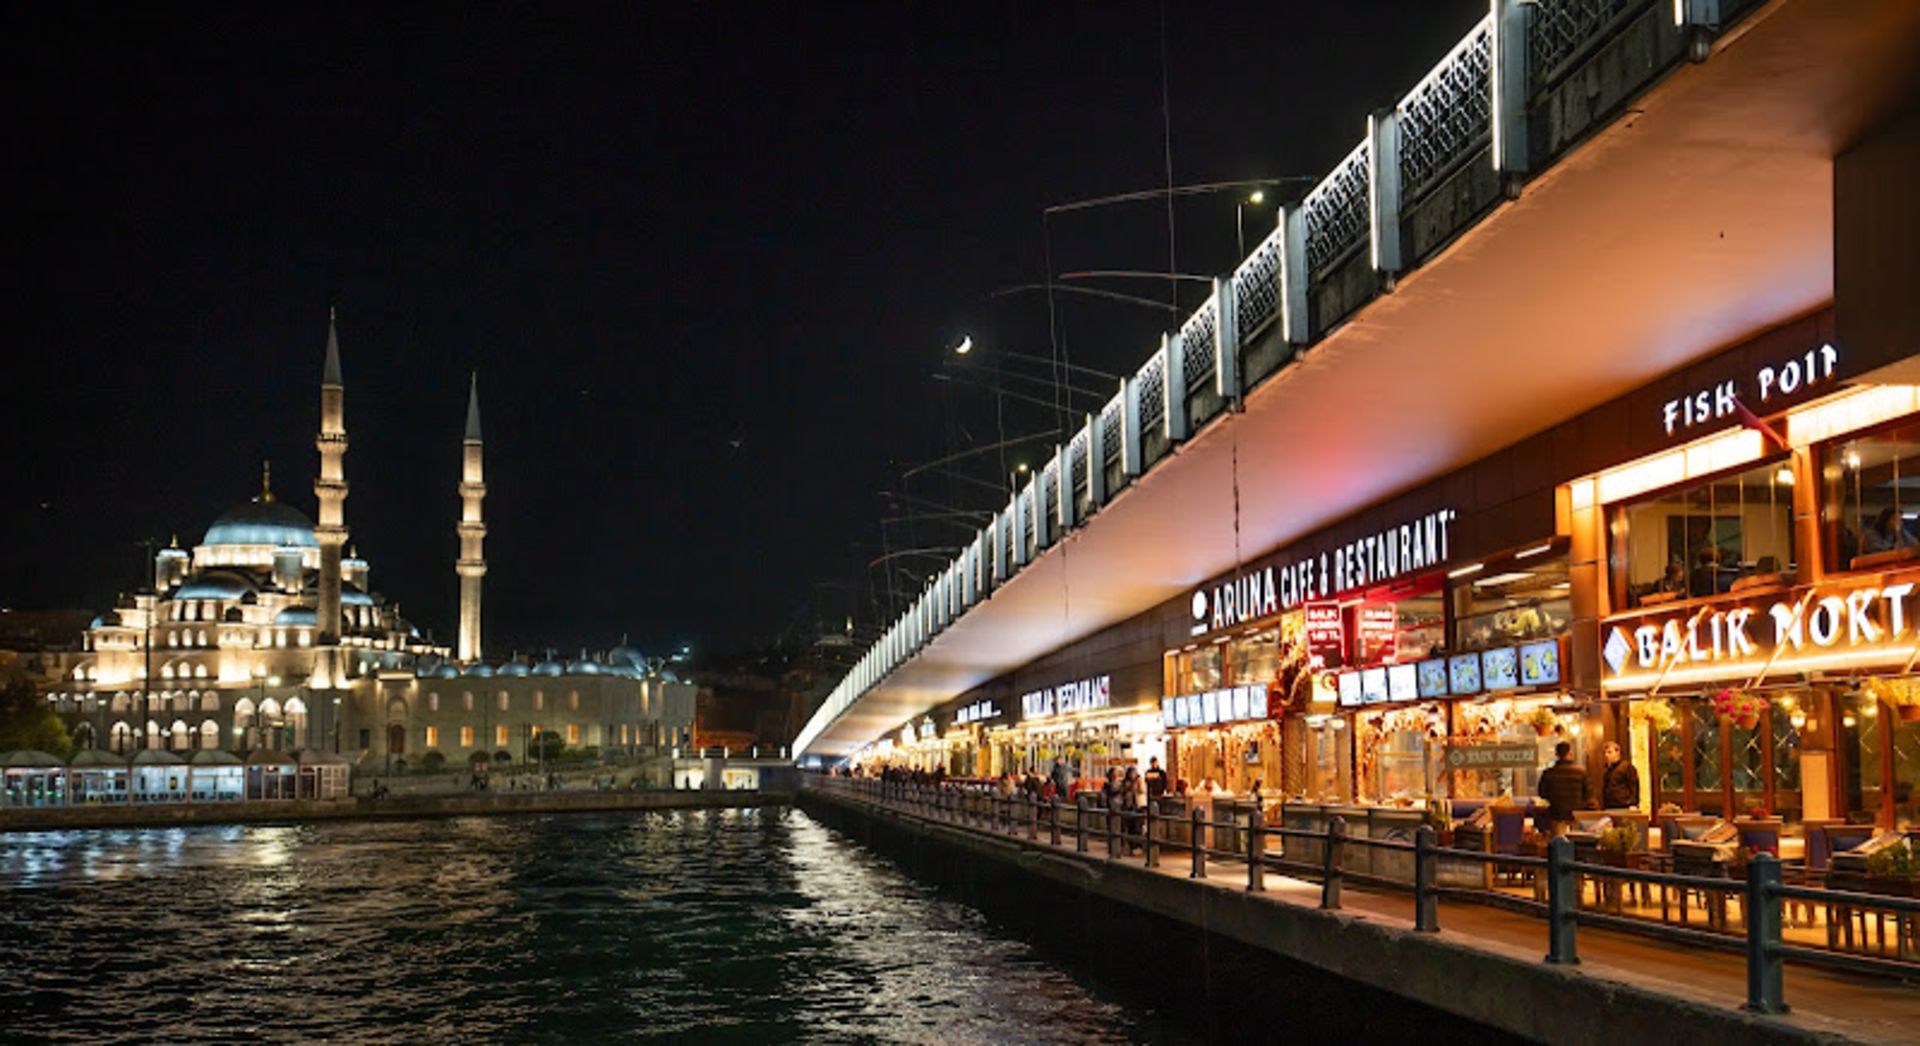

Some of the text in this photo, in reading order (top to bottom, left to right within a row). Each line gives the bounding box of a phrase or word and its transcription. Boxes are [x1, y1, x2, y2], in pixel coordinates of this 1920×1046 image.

[1663, 379, 1737, 436] FISH
[1212, 566, 1277, 630] ARUNA
[1280, 557, 1315, 609] CAFE
[1335, 509, 1449, 591] RESTAURANT
[1634, 581, 1920, 668] BALIK NOKT
